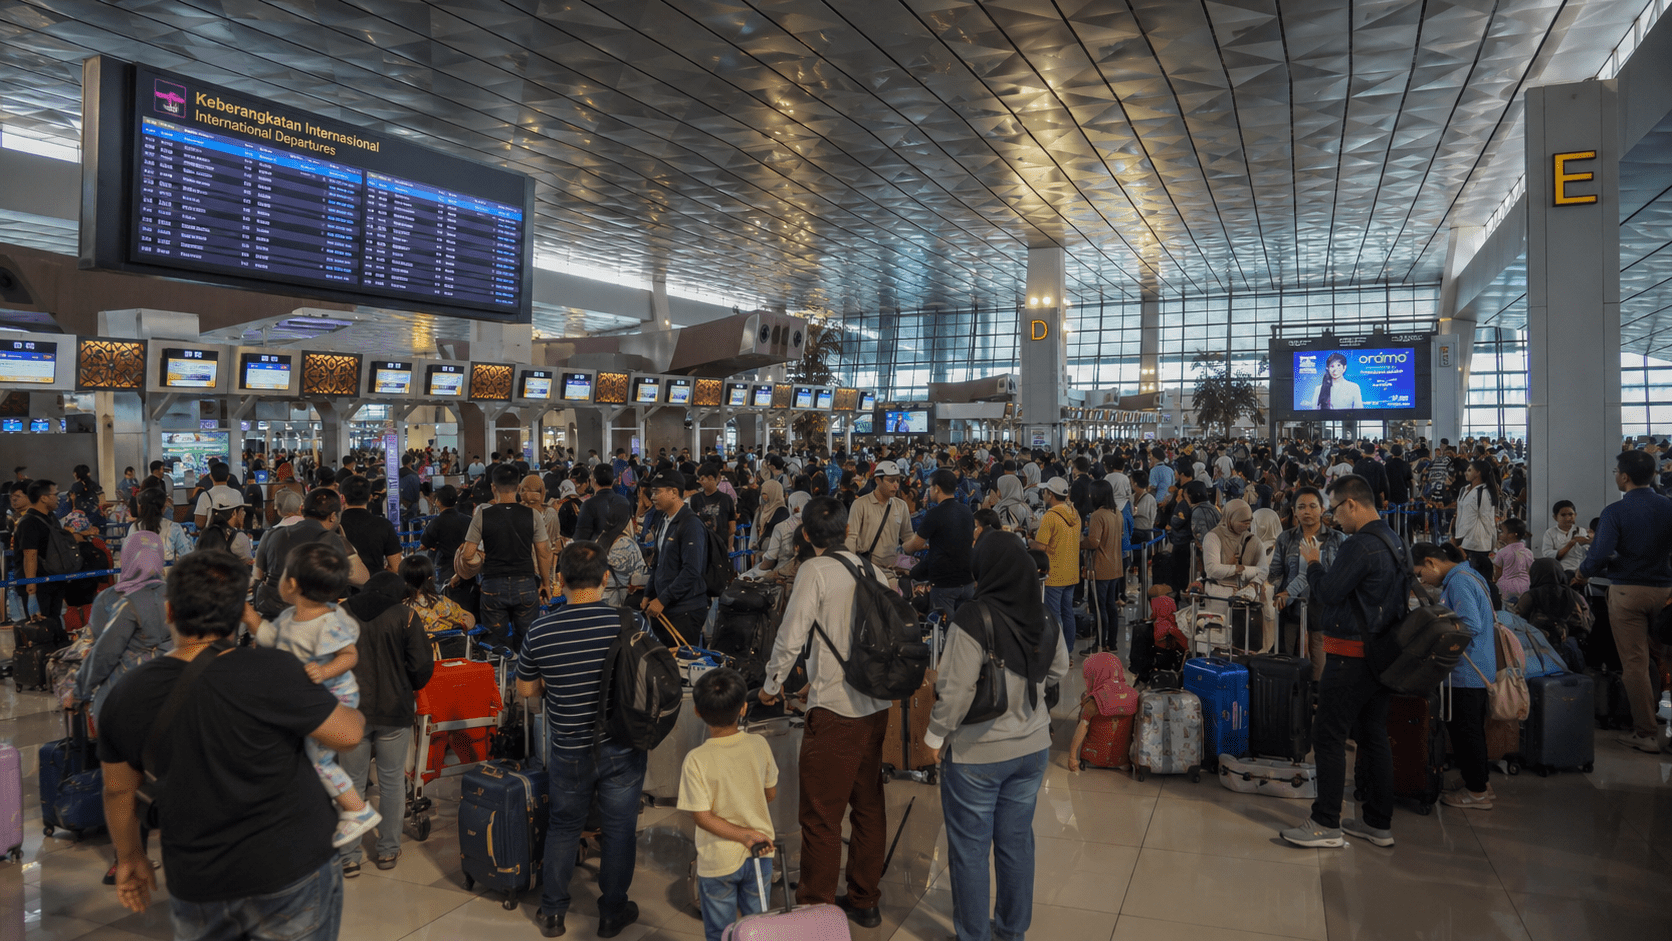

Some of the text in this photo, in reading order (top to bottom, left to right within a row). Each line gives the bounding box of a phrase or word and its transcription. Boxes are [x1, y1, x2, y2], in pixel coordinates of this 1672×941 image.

[195, 91, 380, 153] Keberangkatan Internasional
[195, 109, 272, 140] International
[275, 131, 336, 156] Departures
[1553, 150, 1597, 207] E
[1031, 319, 1048, 340] D
